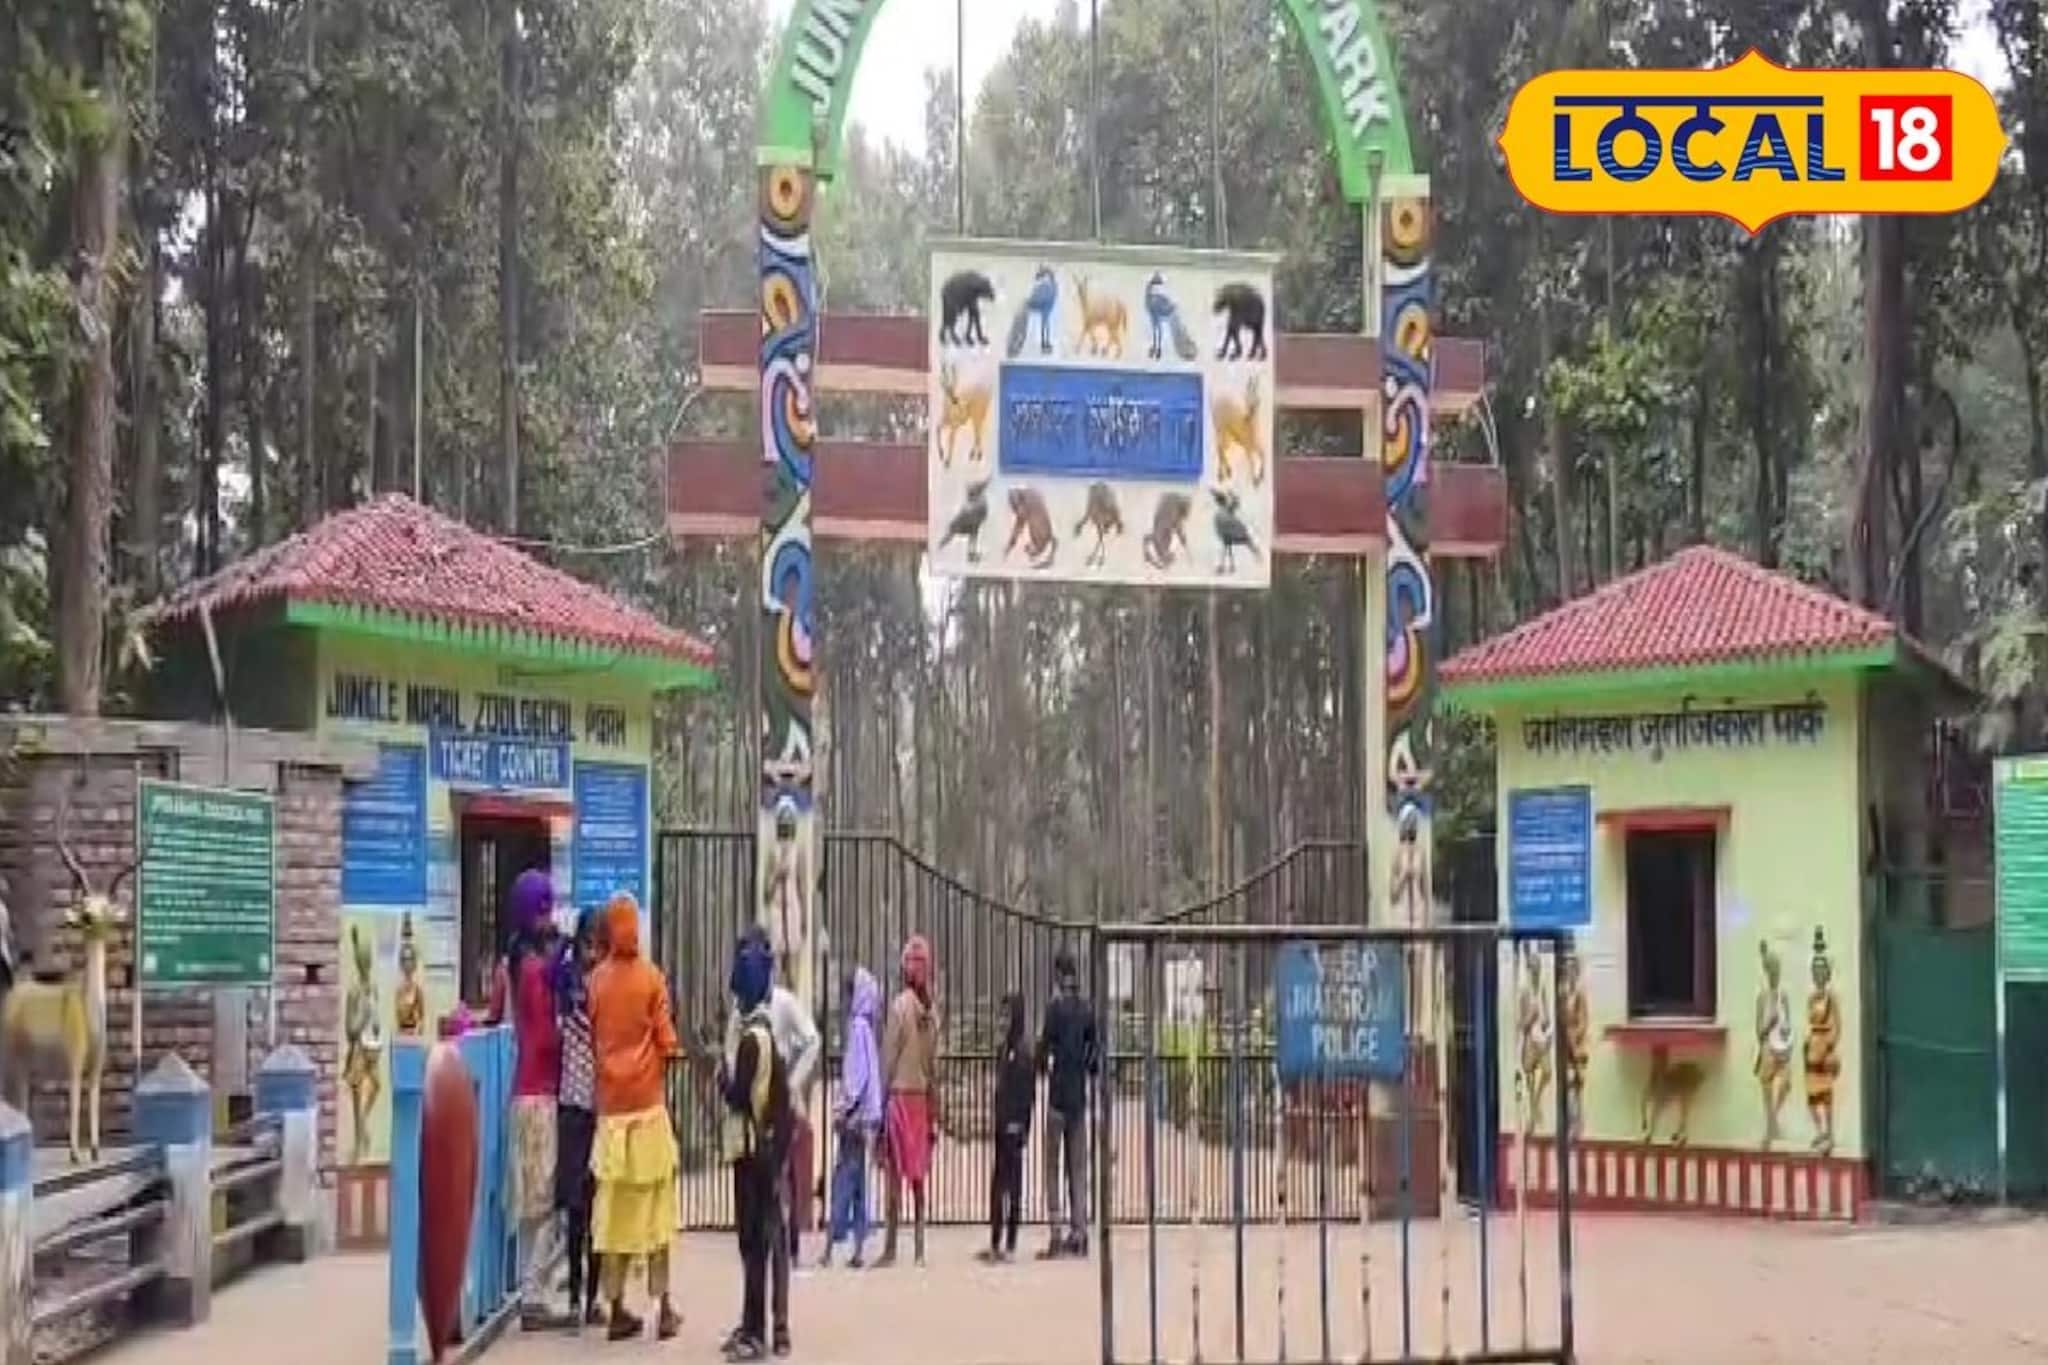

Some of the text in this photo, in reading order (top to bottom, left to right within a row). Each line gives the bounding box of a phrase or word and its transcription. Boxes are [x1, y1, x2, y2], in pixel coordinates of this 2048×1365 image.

[1318, 0, 1393, 138] ARK
[585, 702, 627, 747] PARK
[440, 739, 560, 783] TICKET COUNTER
[1311, 1024, 1379, 1061] POLICE
